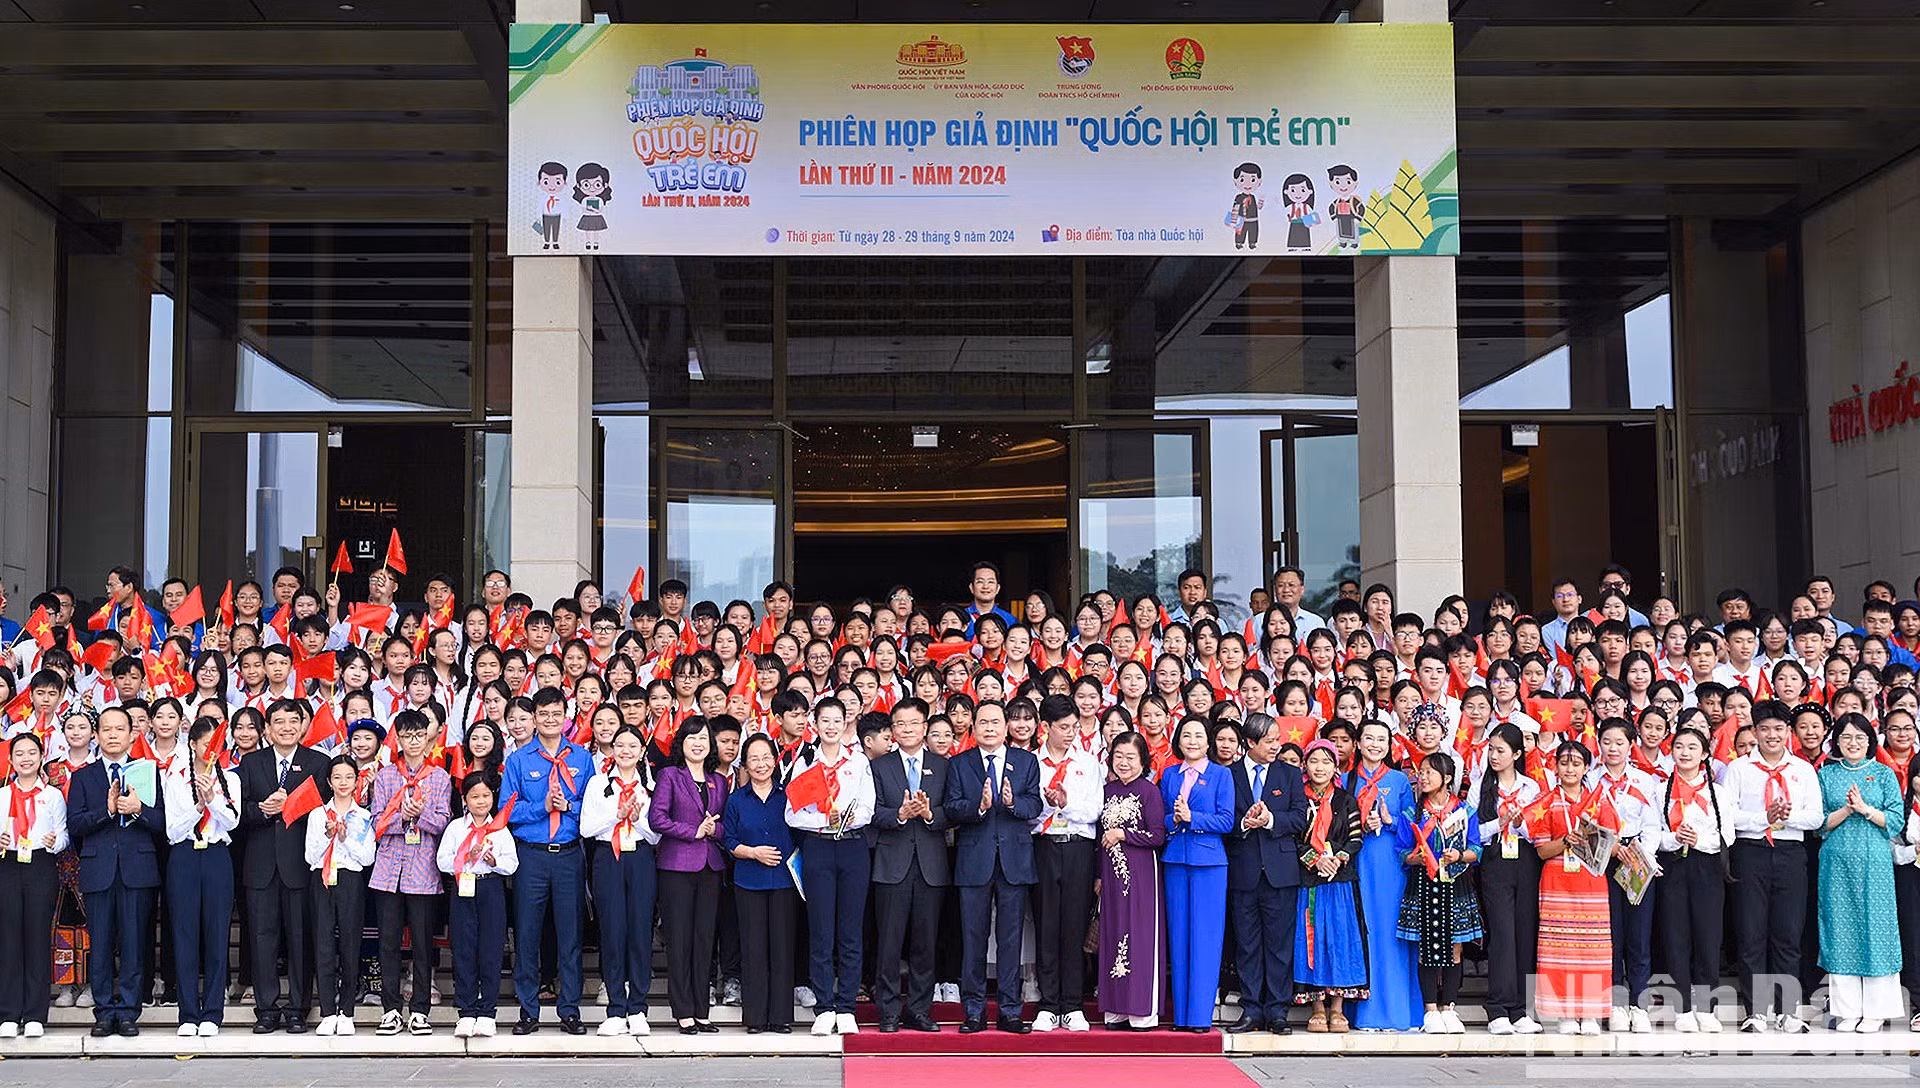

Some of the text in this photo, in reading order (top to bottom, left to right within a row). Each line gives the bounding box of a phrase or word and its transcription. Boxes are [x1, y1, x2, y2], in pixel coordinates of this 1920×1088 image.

[949, 68, 966, 76] NAM
[633, 116, 758, 165] QUỐC HỘI
[799, 115, 877, 146] PHIÊN
[885, 119, 937, 152] HỌP
[945, 111, 988, 146] GIẢ
[995, 120, 1058, 152] ĐỊNH
[1065, 105, 1163, 152] "QUỐC
[1170, 110, 1218, 152] HỘI
[1226, 108, 1281, 146] TRẺ
[647, 157, 747, 192] TRẺ EM
[800, 159, 833, 185] LẦN
[838, 163, 877, 185] THỨ
[880, 166, 894, 185] II
[912, 163, 953, 185] NĂM
[958, 166, 1006, 185] 2024
[723, 196, 750, 207] 2024
[787, 230, 808, 243] Thời
[811, 232, 836, 246] gian:
[854, 231, 879, 246] ngày
[882, 231, 896, 243] 28
[905, 231, 918, 243] 29
[922, 230, 951, 246] tháng
[953, 231, 961, 243] 9
[964, 231, 986, 243] năm
[989, 231, 1016, 243] 2024
[1066, 226, 1204, 243] Địa điểm: Tòa nhà Quốc hội
[1829, 383, 1867, 443] NHÀ
